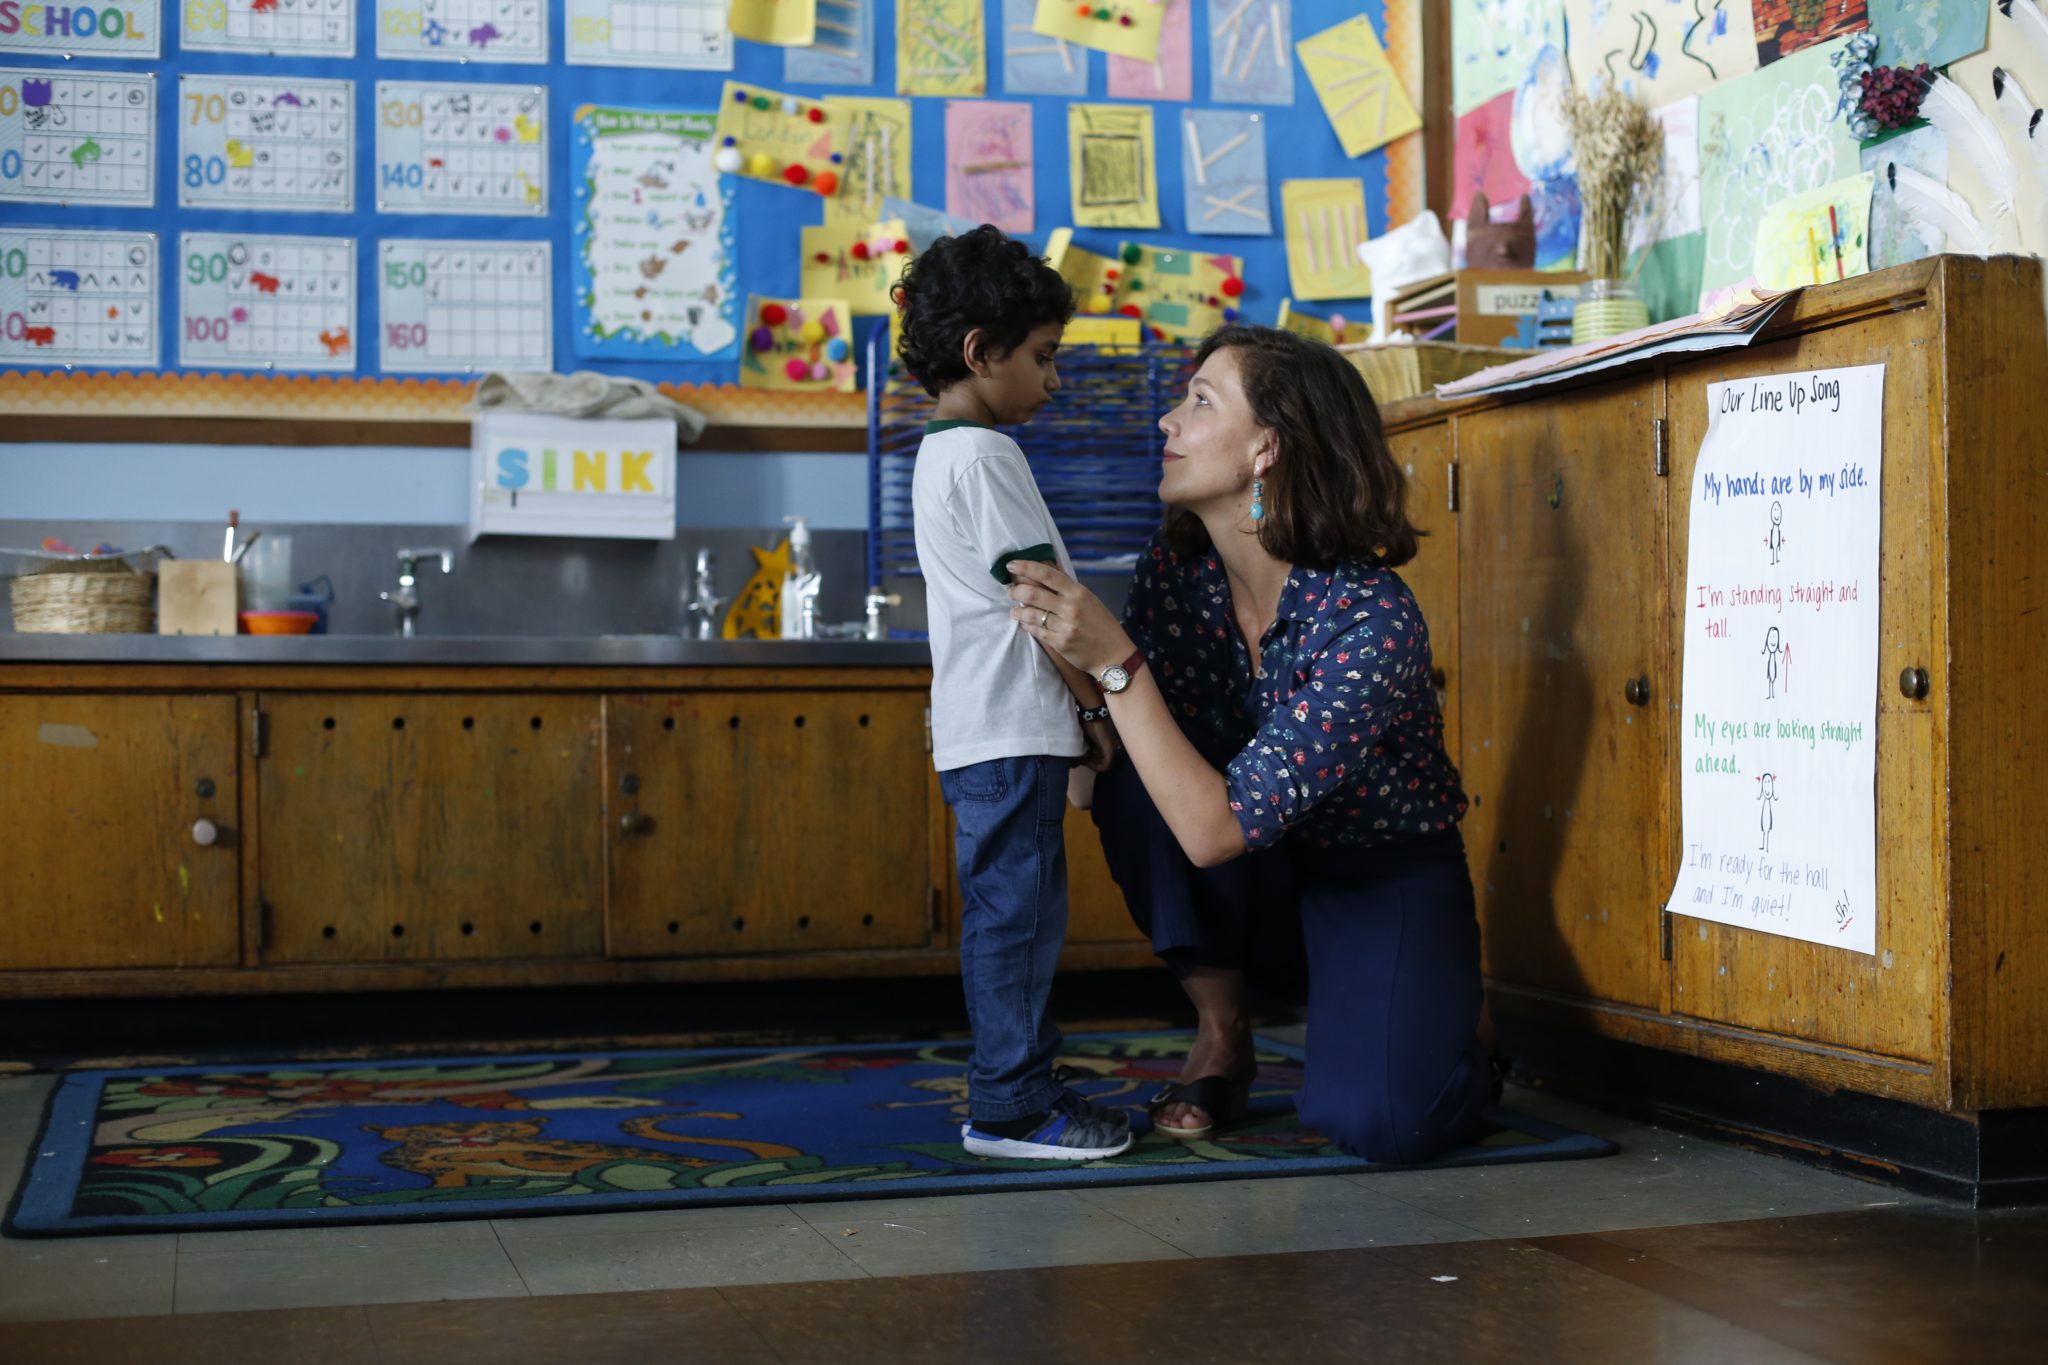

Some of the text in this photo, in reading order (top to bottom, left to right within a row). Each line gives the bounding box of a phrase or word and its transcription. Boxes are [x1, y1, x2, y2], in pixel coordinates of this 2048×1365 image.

[0, 1, 145, 39] SCHOOL
[186, 0, 226, 32] 60
[383, 10, 422, 36] 120
[186, 93, 225, 125] 70
[383, 100, 423, 128] 130
[184, 154, 225, 188] 80
[382, 162, 423, 189] 140
[187, 253, 228, 285] 90
[385, 261, 427, 289] 150
[185, 316, 229, 342] 100
[387, 323, 428, 350] 160
[1721, 375, 1841, 415] Our Line Up Song
[496, 448, 655, 493] SINK
[1704, 462, 1868, 506] My hands are by my side.
[1697, 579, 1859, 614] I'm standing straight and
[1705, 617, 1732, 639] tall.
[1694, 712, 1863, 751] My eyes are looking straight
[1695, 751, 1742, 775] ahead.
[1688, 843, 1829, 892] I'm ready for the hall
[1692, 885, 1793, 923] and I'm quiet!
